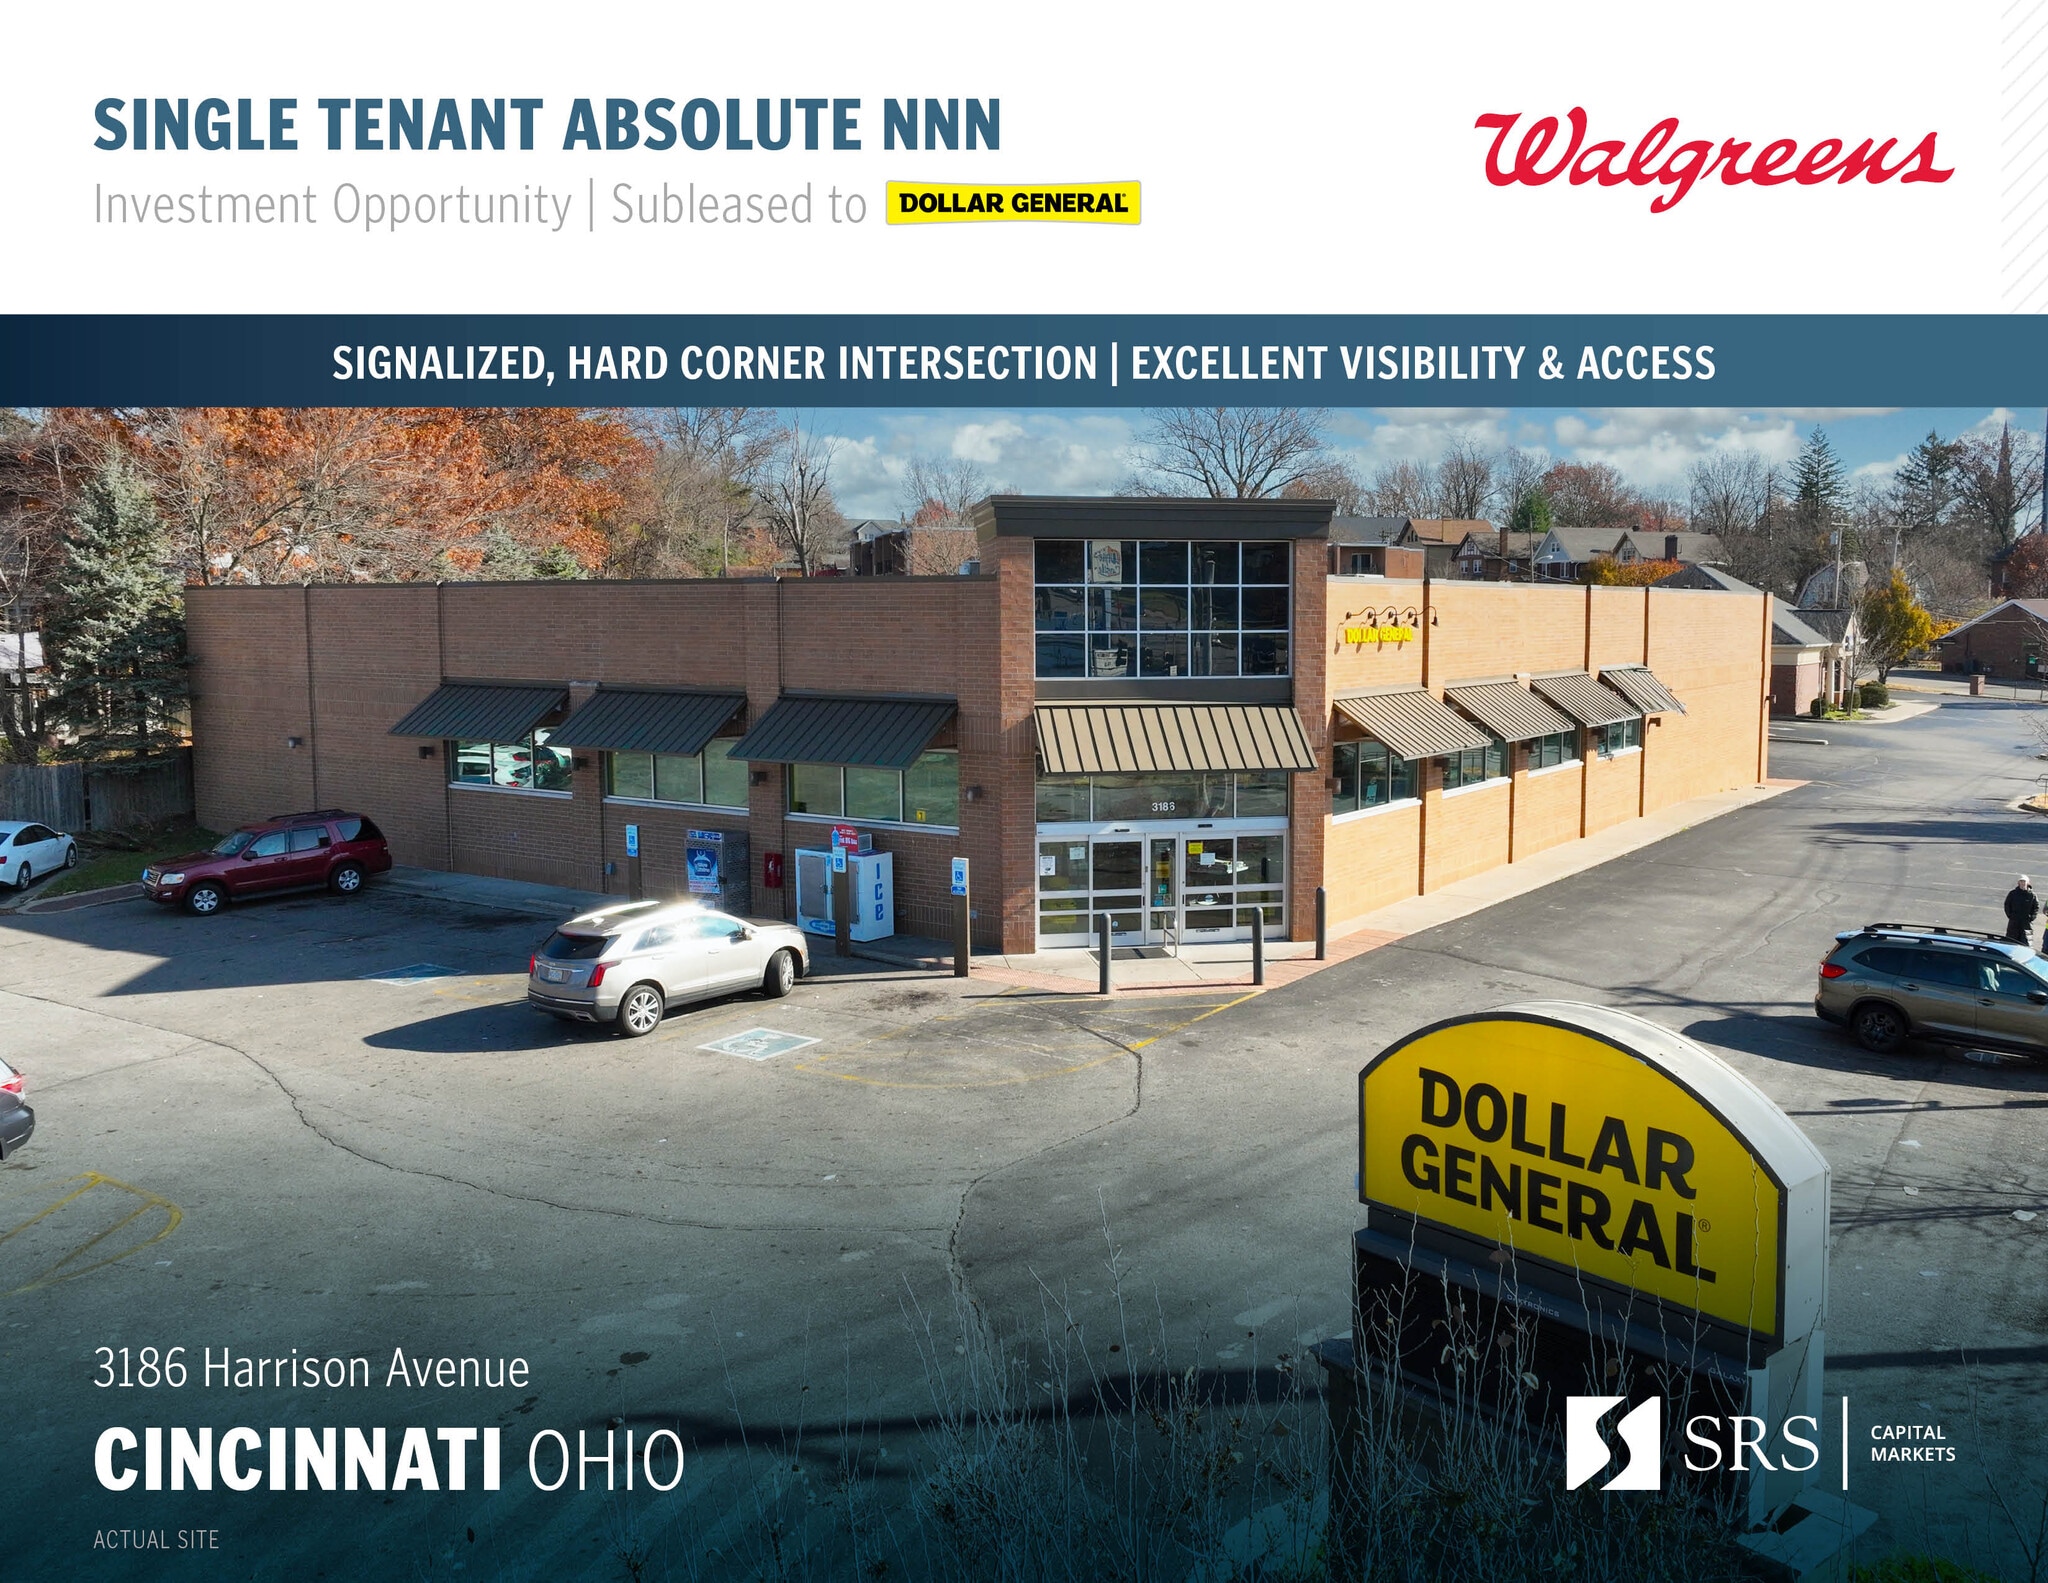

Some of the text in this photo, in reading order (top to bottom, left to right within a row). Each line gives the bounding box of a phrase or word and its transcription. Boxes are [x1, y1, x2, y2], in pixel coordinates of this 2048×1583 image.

[1151, 801, 1176, 812] 3186
[1419, 1067, 1697, 1200] DOLLAR
[1401, 1133, 1717, 1284] GENERAL
[1506, 1293, 1560, 1318] DKTRONICS
